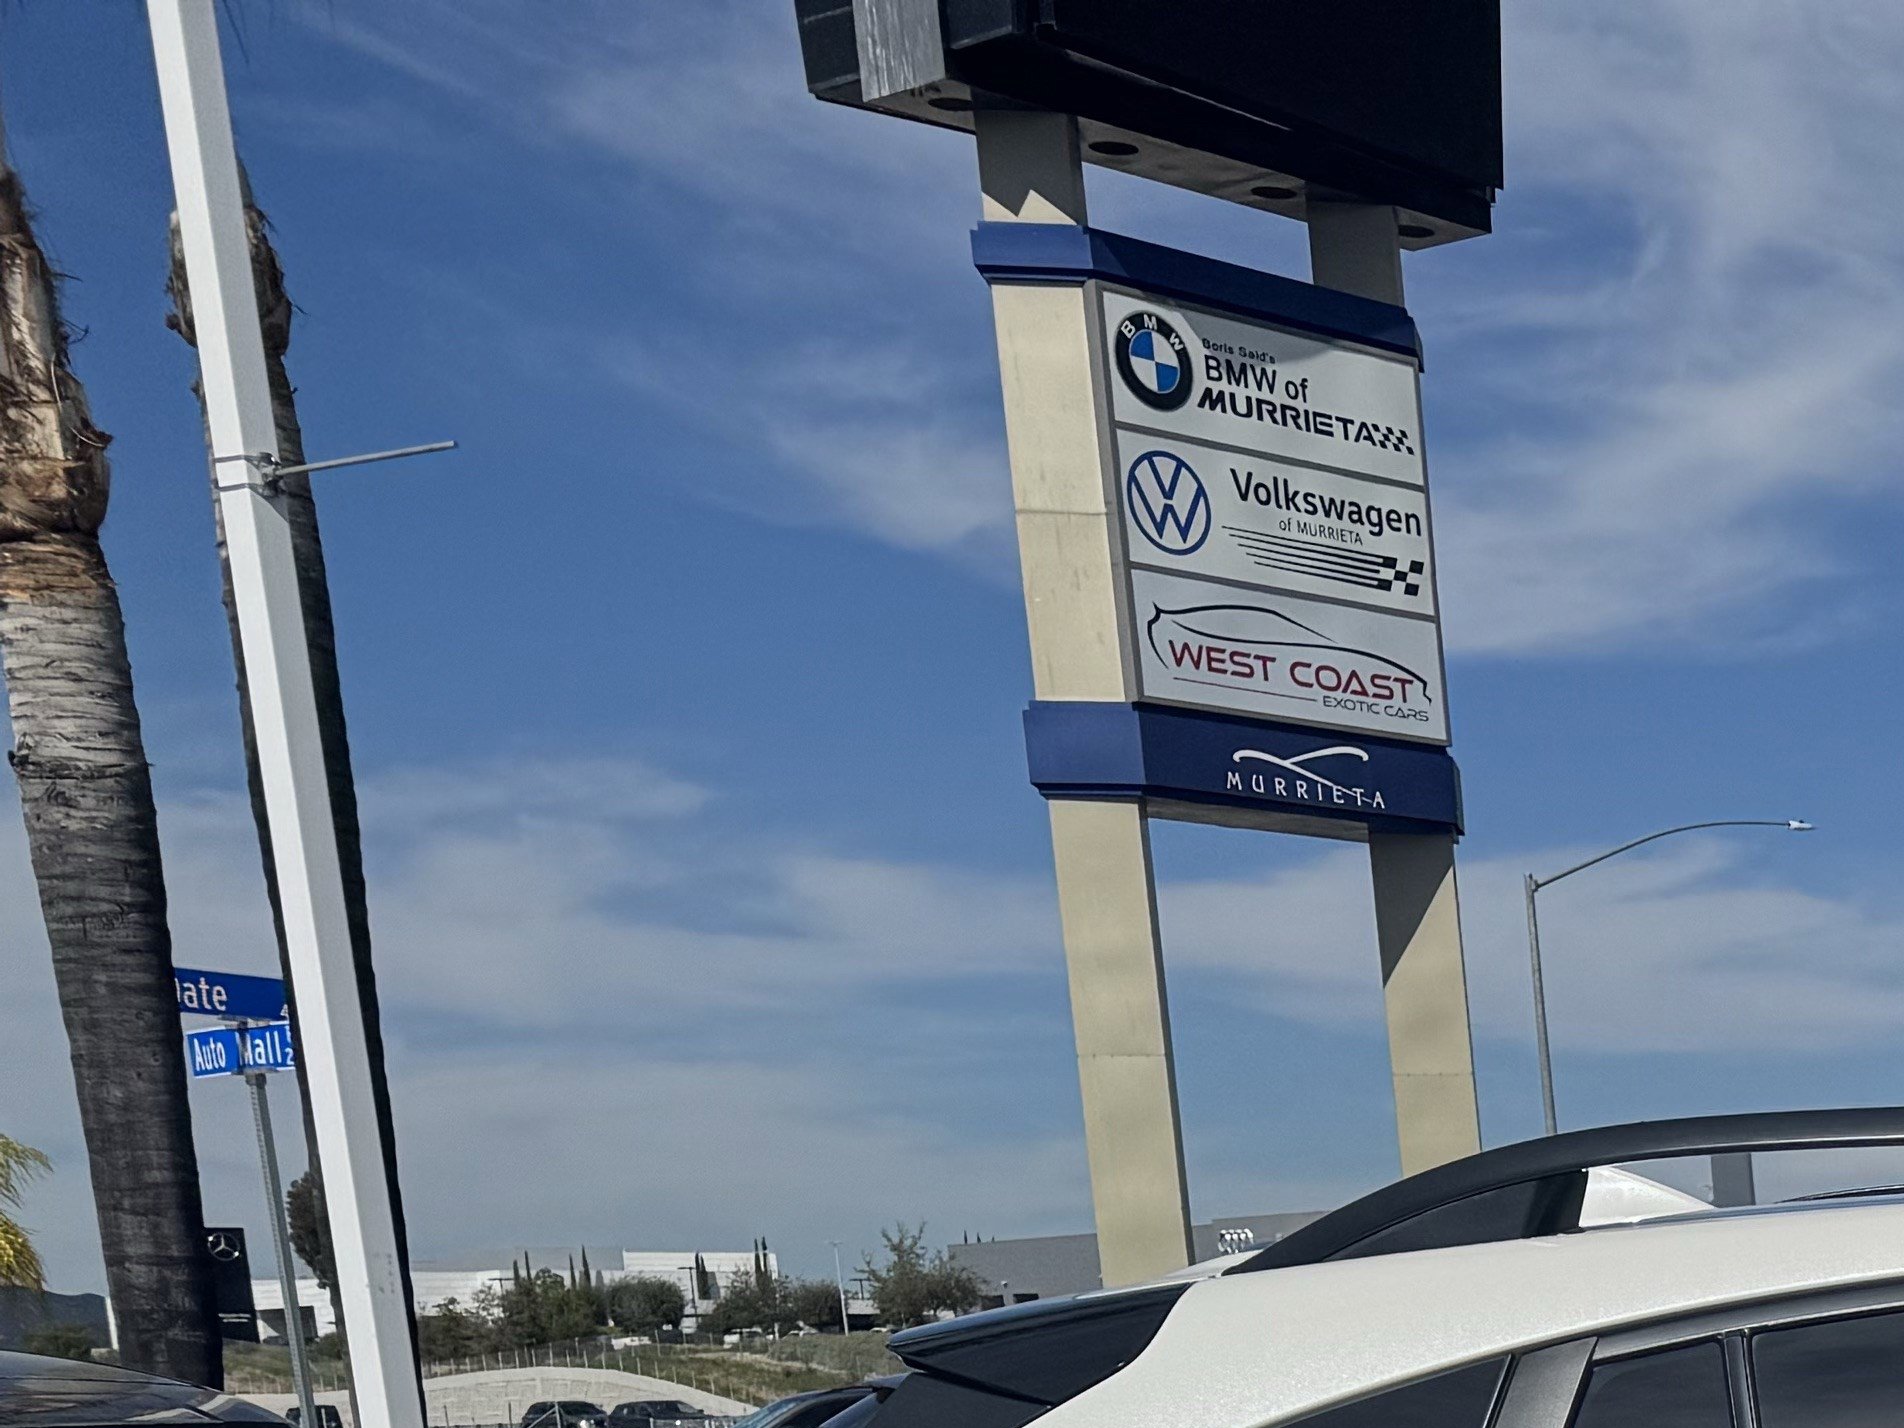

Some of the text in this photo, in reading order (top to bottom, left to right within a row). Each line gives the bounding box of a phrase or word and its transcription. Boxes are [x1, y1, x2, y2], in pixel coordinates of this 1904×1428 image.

[1120, 313, 1184, 351] BMW
[1204, 354, 1308, 403] BMW of
[1197, 387, 1378, 447] MURRIETA
[1229, 468, 1422, 537] Volkswagen
[1279, 518, 1364, 546] of MURRIETA
[1168, 639, 1414, 704] WEST COAST
[1322, 695, 1430, 722] EXOTIC CARS
[1226, 771, 1386, 809] MURRIETA
[174, 976, 228, 1011] ate
[193, 1036, 226, 1072] Auto
